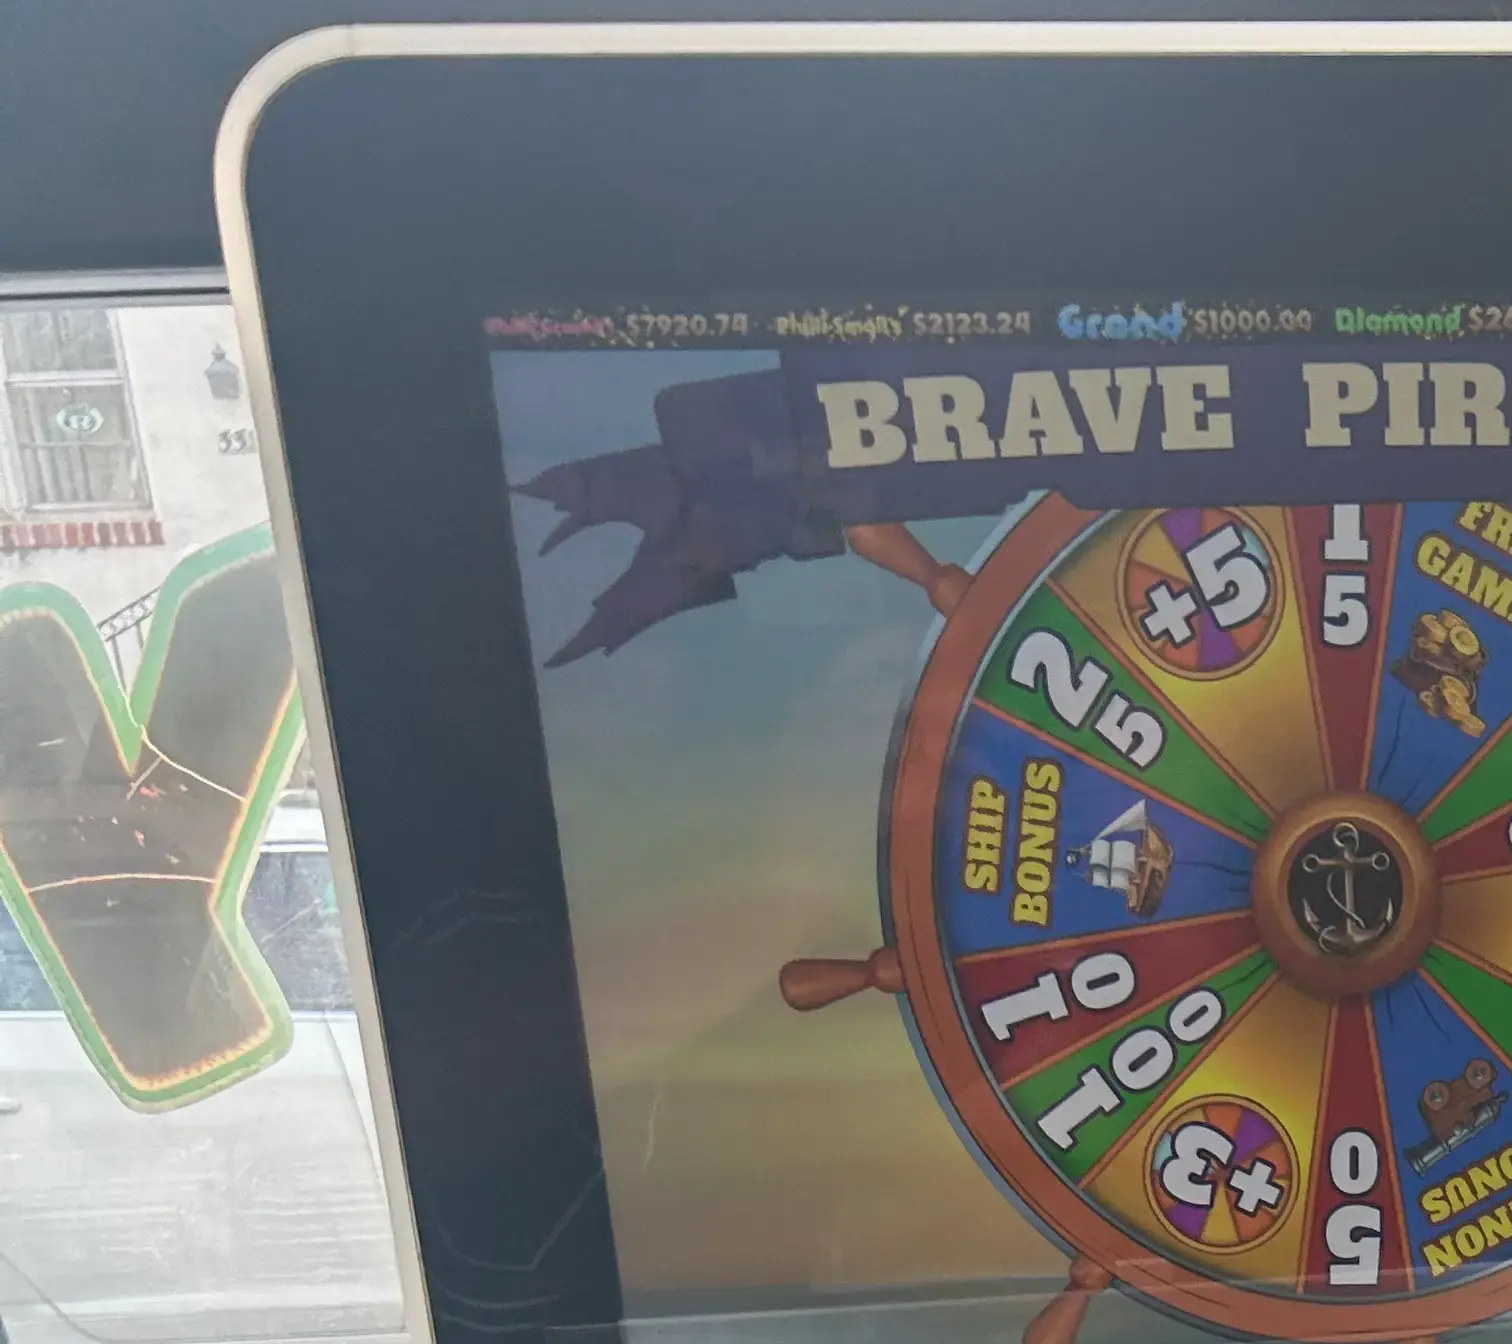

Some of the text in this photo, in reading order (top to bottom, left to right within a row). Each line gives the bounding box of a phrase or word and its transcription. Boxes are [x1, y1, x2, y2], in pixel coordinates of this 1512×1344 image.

[625, 312, 749, 337] $7920.74
[913, 310, 1031, 336] $2123.24
[1057, 300, 1184, 340] Grand
[1193, 308, 1312, 333] $1000.00
[817, 365, 1234, 468] BRAVE
[1141, 523, 1270, 647] +5
[1323, 504, 1369, 646] 15
[1008, 628, 1165, 770] 25
[965, 780, 1005, 892] SHIP
[1012, 760, 1062, 926] BONUS
[981, 953, 1135, 1040] 10
[1038, 991, 1222, 1149] 100
[1163, 1125, 1282, 1213] +3
[1326, 1131, 1382, 1285] 50
